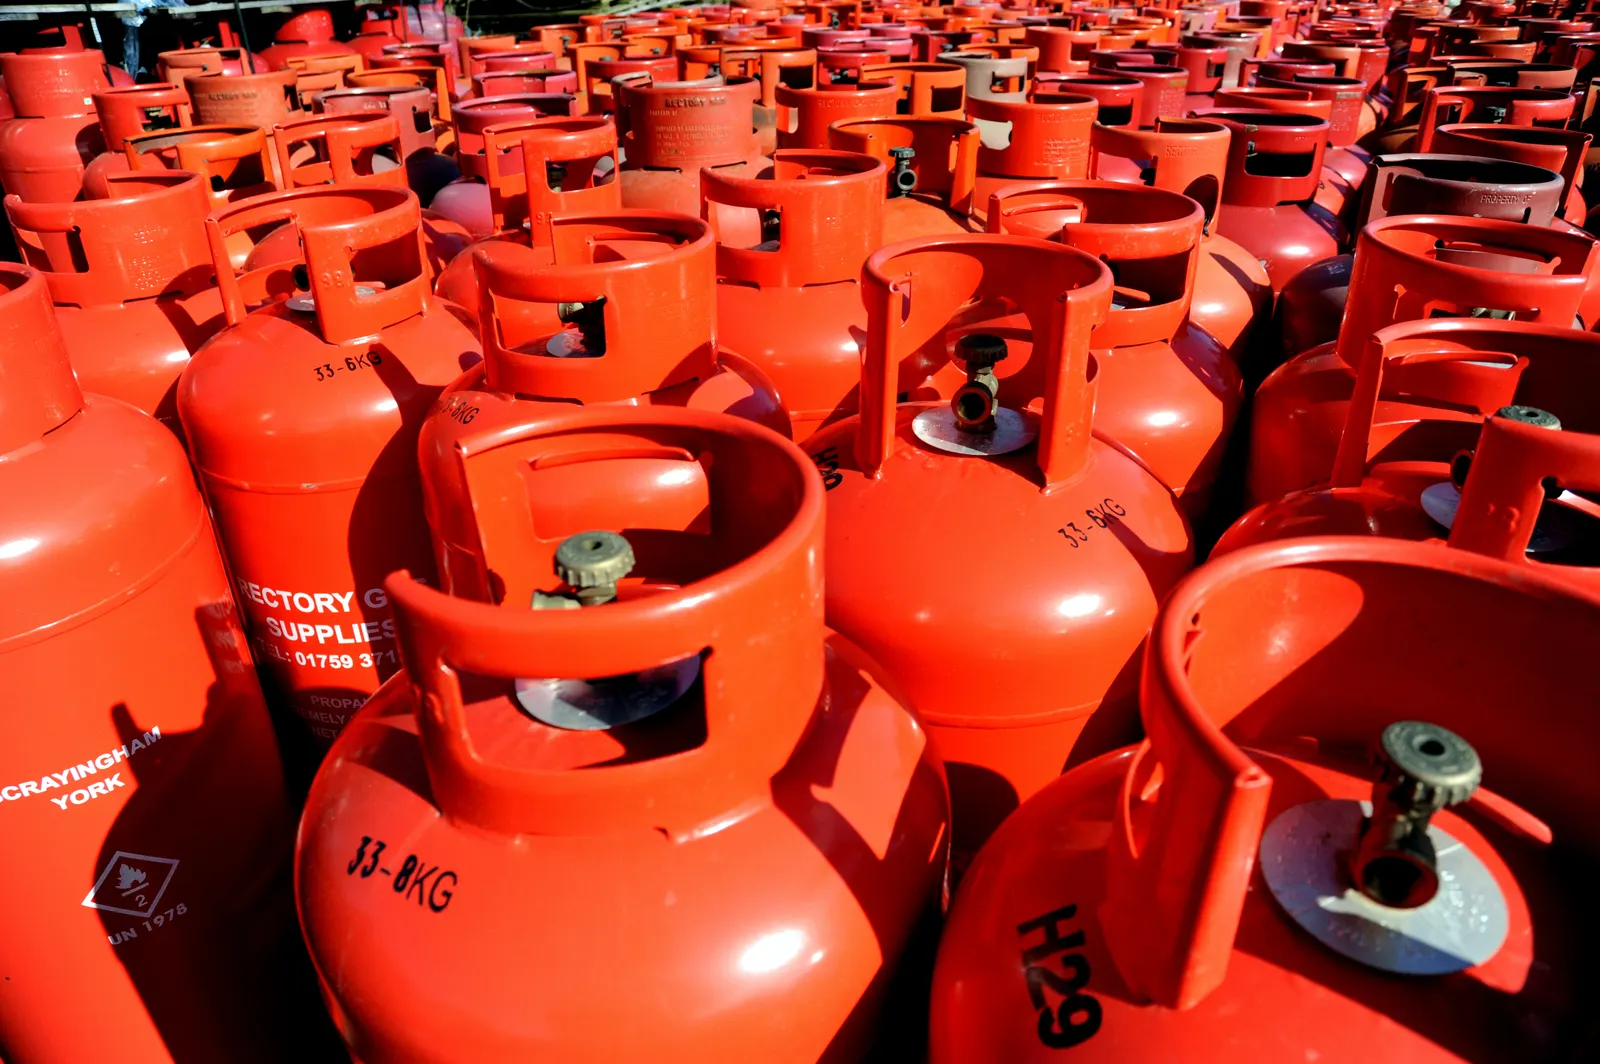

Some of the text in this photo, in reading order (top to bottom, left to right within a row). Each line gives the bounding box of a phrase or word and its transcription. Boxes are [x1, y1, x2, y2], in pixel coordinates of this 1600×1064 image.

[1480, 194, 1533, 205] PROPERTY OF
[313, 351, 382, 382] 33-6KG
[1057, 498, 1127, 549] 33-6KG
[236, 576, 354, 614] RECTORY
[266, 616, 397, 645] SUPPLIES
[294, 651, 354, 669] 01759
[359, 649, 398, 668] 371
[50, 772, 126, 811] YORK
[346, 835, 458, 914] 33-8KG
[134, 893, 149, 908] 2
[107, 902, 189, 946] UN 1978
[1015, 903, 1103, 1050] H29
